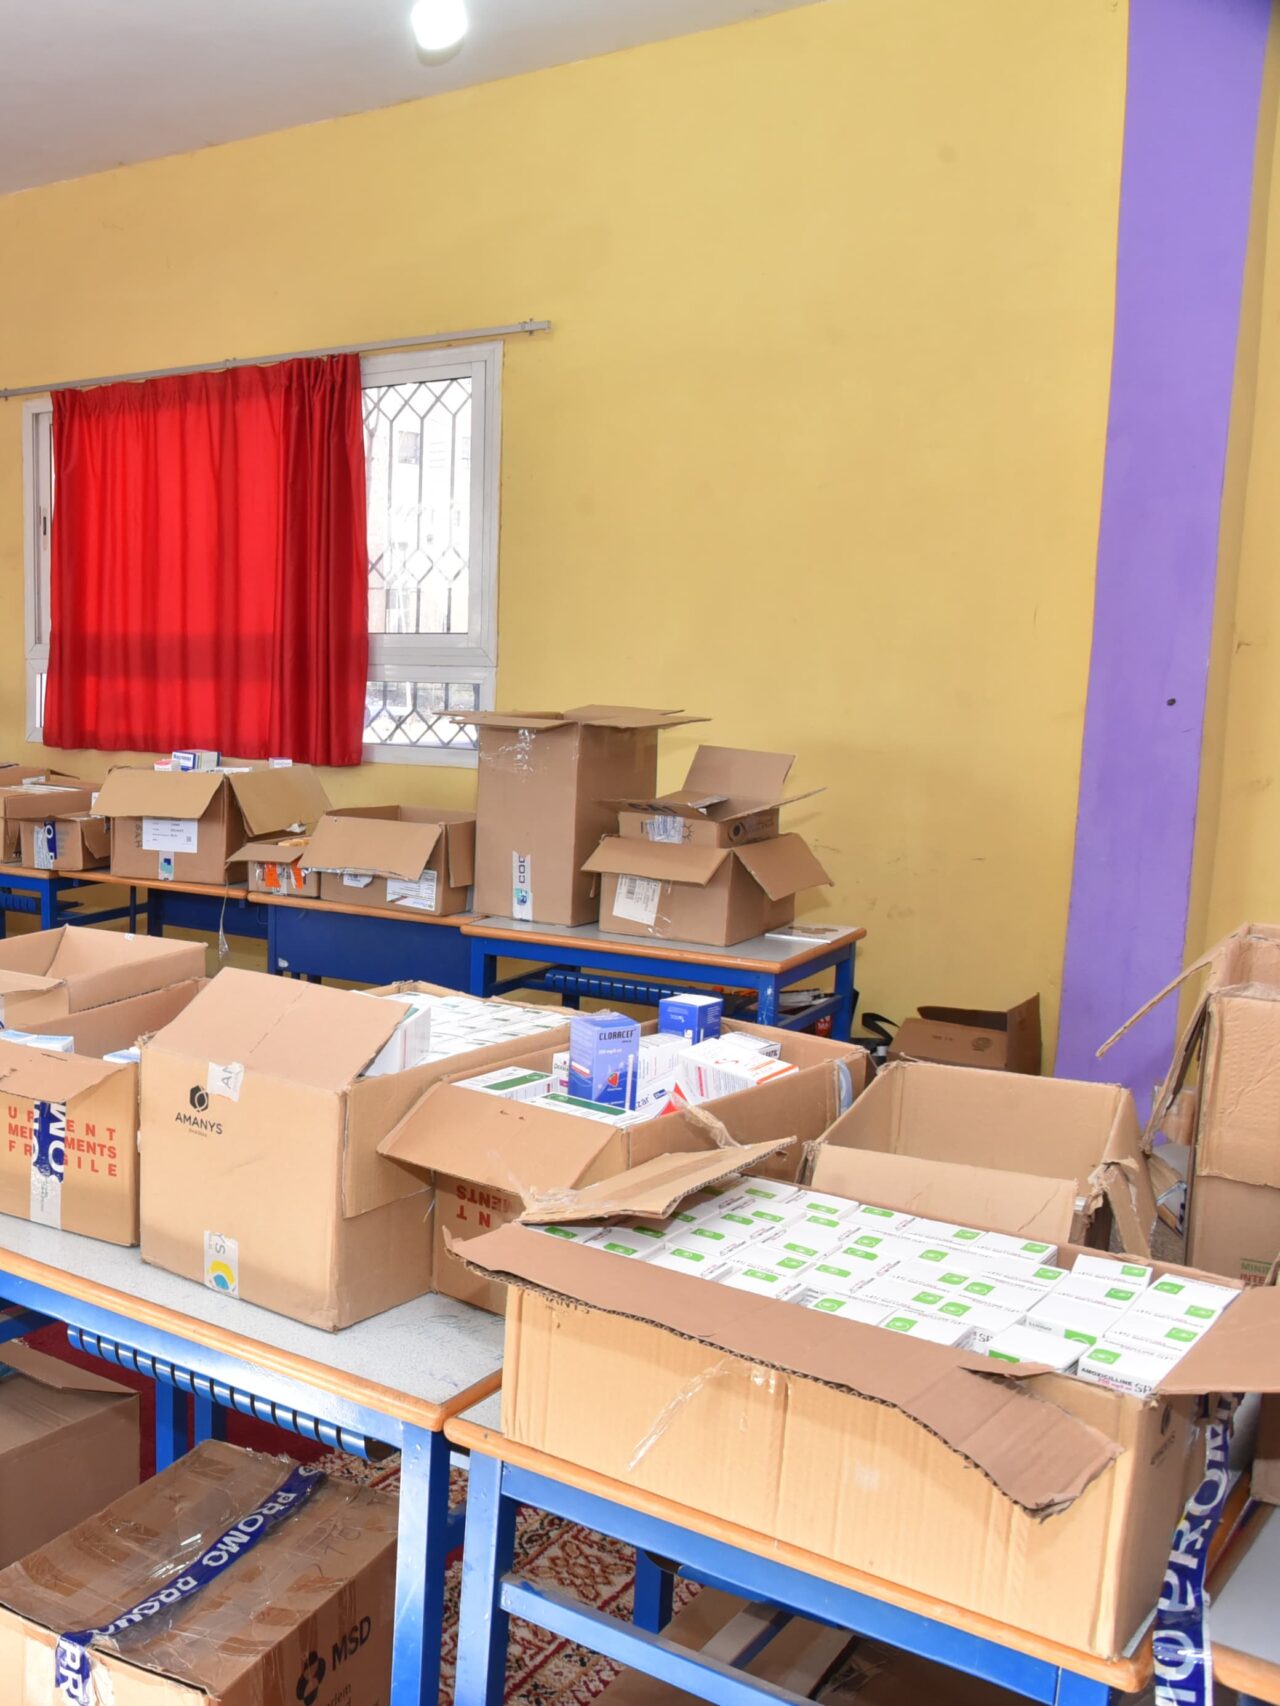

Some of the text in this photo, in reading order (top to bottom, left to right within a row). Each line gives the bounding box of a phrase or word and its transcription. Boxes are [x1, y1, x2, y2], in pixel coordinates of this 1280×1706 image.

[598, 1028, 635, 1041] CLORACEF
[175, 1111, 223, 1135] AMANYS
[1081, 1367, 1132, 1387] AMOXICILLINE
[201, 1491, 298, 1567] PROMO
[332, 1615, 371, 1671] MSD
